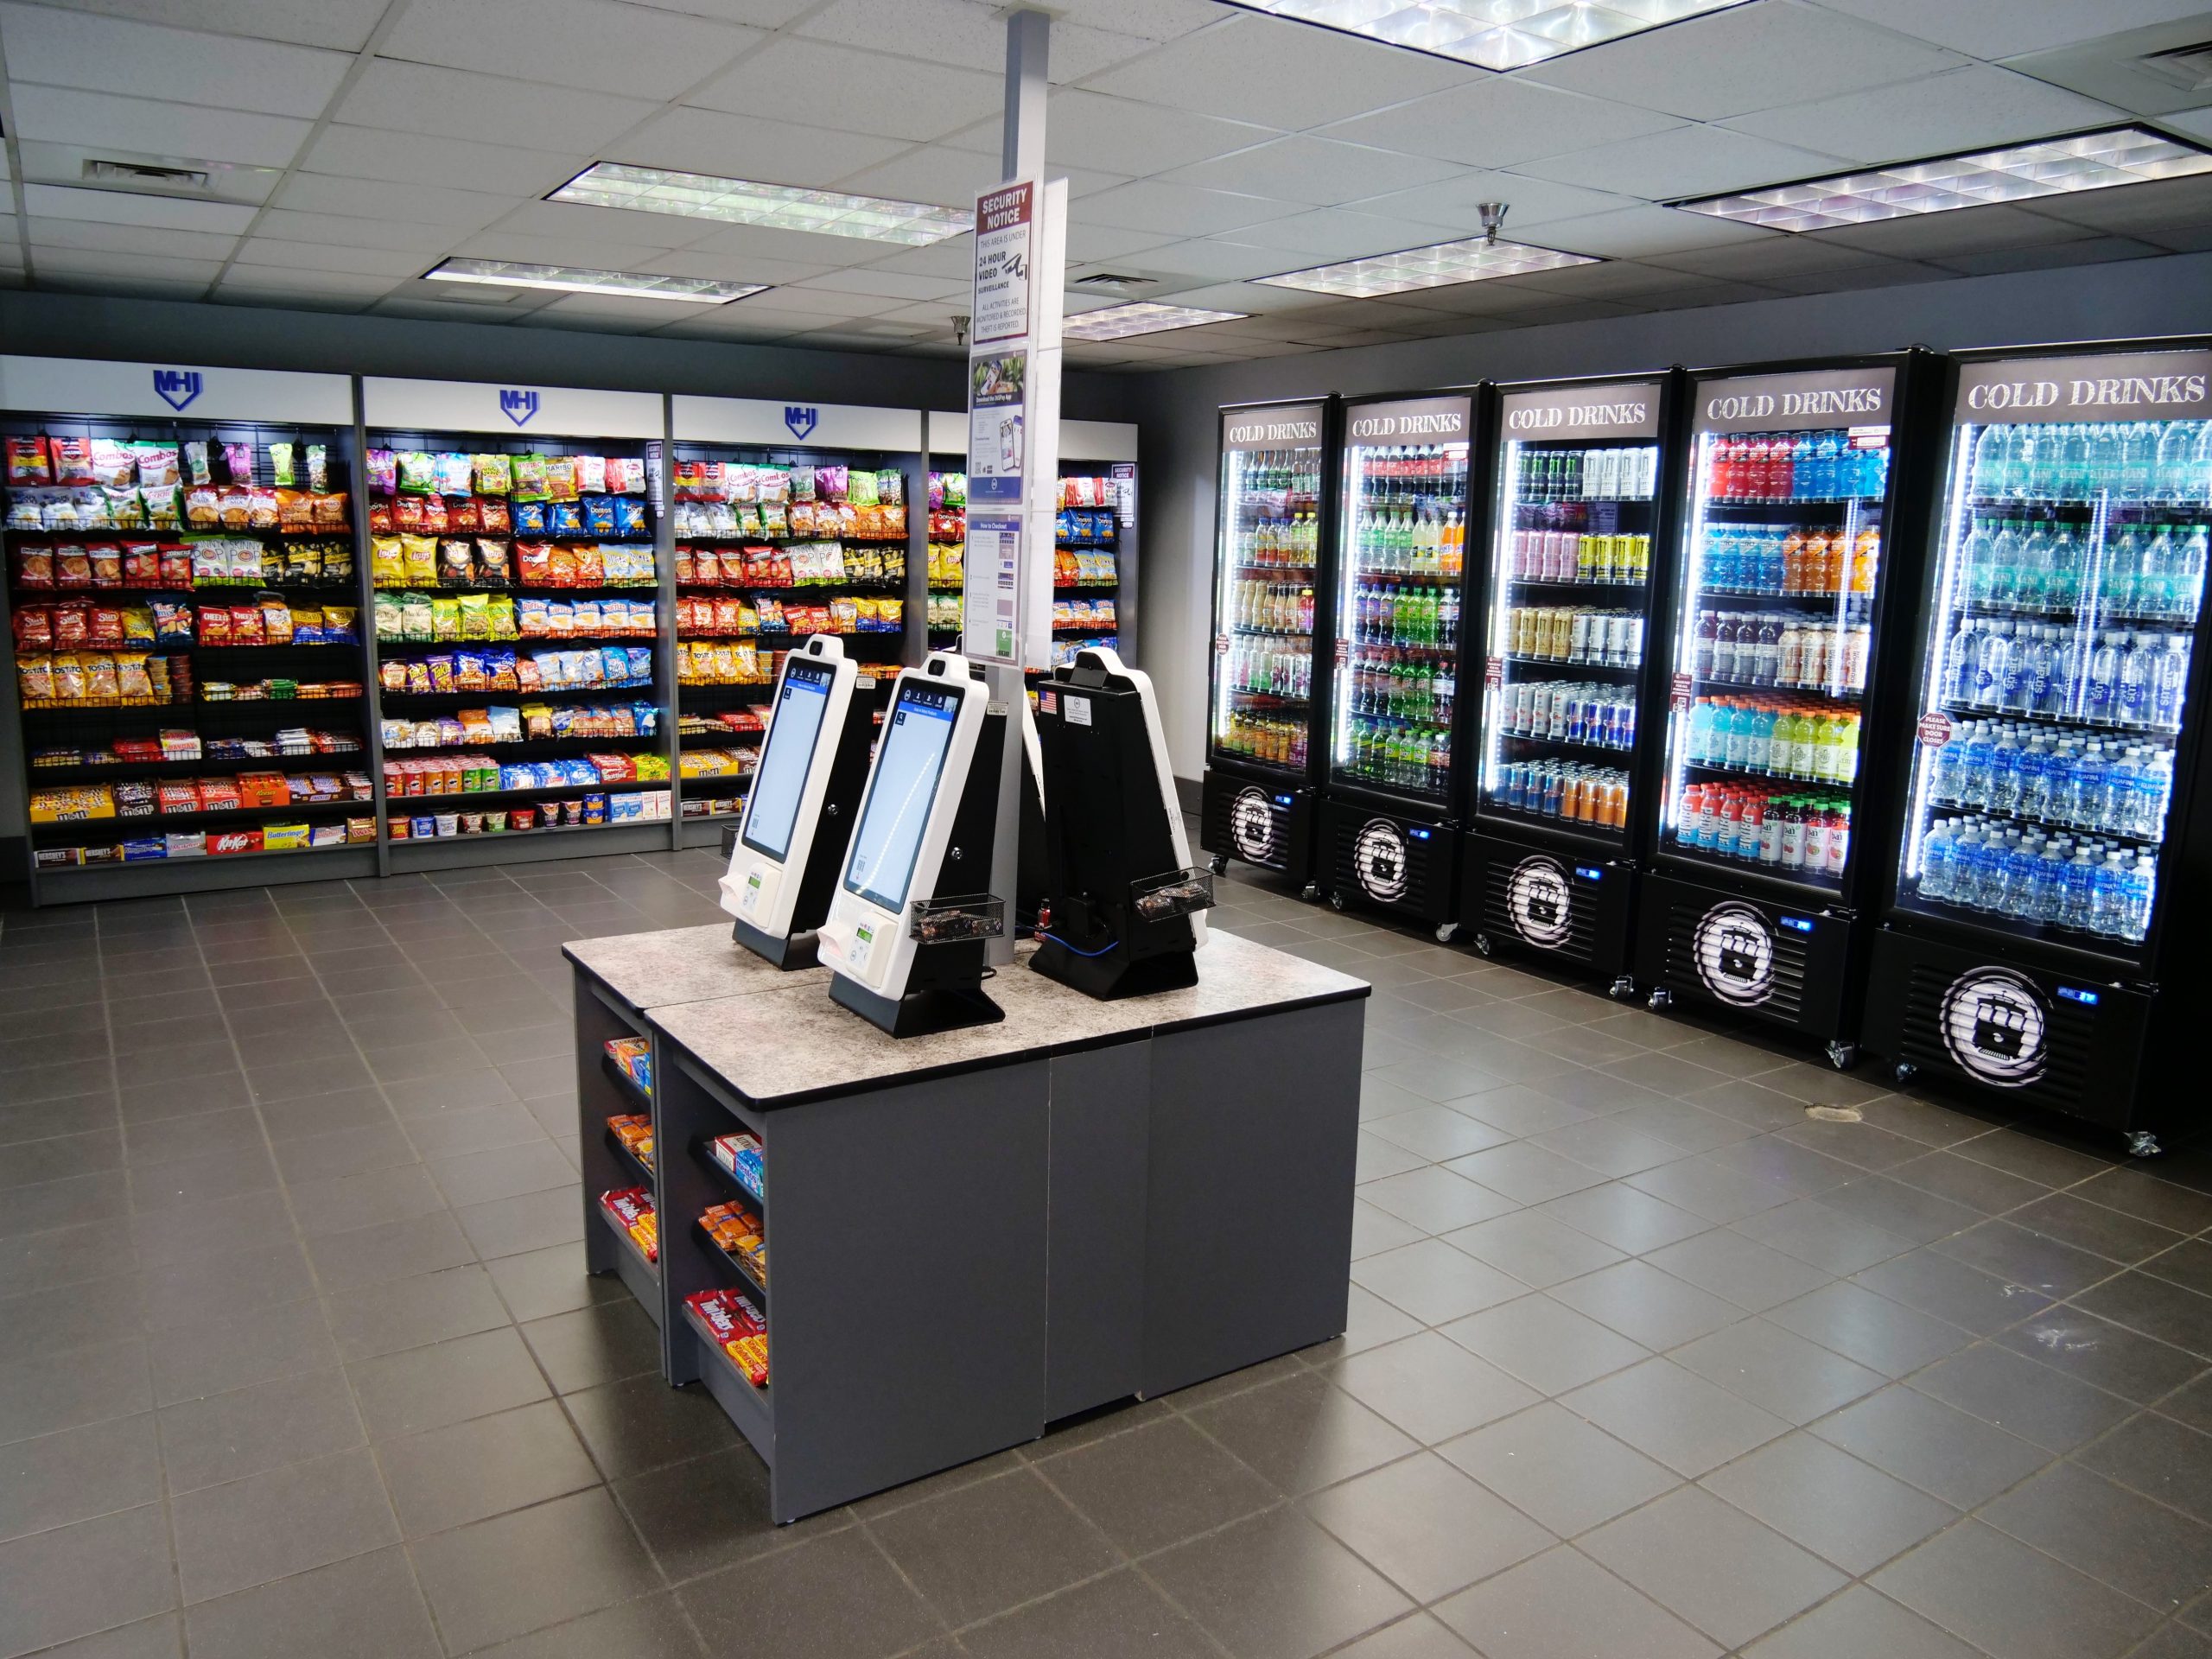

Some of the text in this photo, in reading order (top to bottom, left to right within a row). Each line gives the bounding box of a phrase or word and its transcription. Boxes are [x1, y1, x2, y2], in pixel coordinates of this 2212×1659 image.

[982, 188, 1027, 215] SECURITY
[987, 207, 1020, 231] NOTICE
[981, 230, 1027, 249] THIS AREA IS UNDER
[979, 251, 1007, 267] 24 HOUR
[978, 268, 997, 282] VIDEO
[978, 281, 1009, 295] SURVEILLANCE
[1011, 296, 1020, 305] ARE
[1967, 374, 2207, 410] COLD DRINKS
[1707, 388, 1882, 421] COLD DRINKS
[1509, 403, 1646, 430] COLD DRINKS
[1229, 421, 1317, 443] COLD DRINKS
[1351, 413, 1461, 437] COLD DRINKS
[93, 451, 134, 461] Combos
[138, 449, 177, 464] Combos
[230, 540, 260, 551] SKINNY
[1976, 650, 1988, 685] smart
[2005, 656, 2018, 690] smart
[2034, 659, 2047, 695] smart
[1940, 750, 1958, 759] UAFINA
[1962, 754, 1983, 763] UAFINA
[1990, 760, 2007, 768] UAFINA
[2018, 764, 2040, 772] QUAFINA
[2045, 768, 2067, 777] QUAFINA
[2111, 778, 2135, 786] QUAFINA
[2141, 782, 2164, 791] QUAFINA
[1678, 803, 1693, 838] PRIME
[1700, 806, 1713, 841] PRIME
[267, 830, 305, 839] Butterfinger
[1739, 814, 1754, 850] PRIME
[1952, 853, 1971, 861] UAFINA
[2008, 863, 2028, 873] QUAFINA
[2034, 869, 2055, 879] QUAFINA
[2065, 877, 2087, 886] QUAFINA
[2126, 887, 2148, 896] QUAFINA
[735, 1160, 757, 1184] mentos
